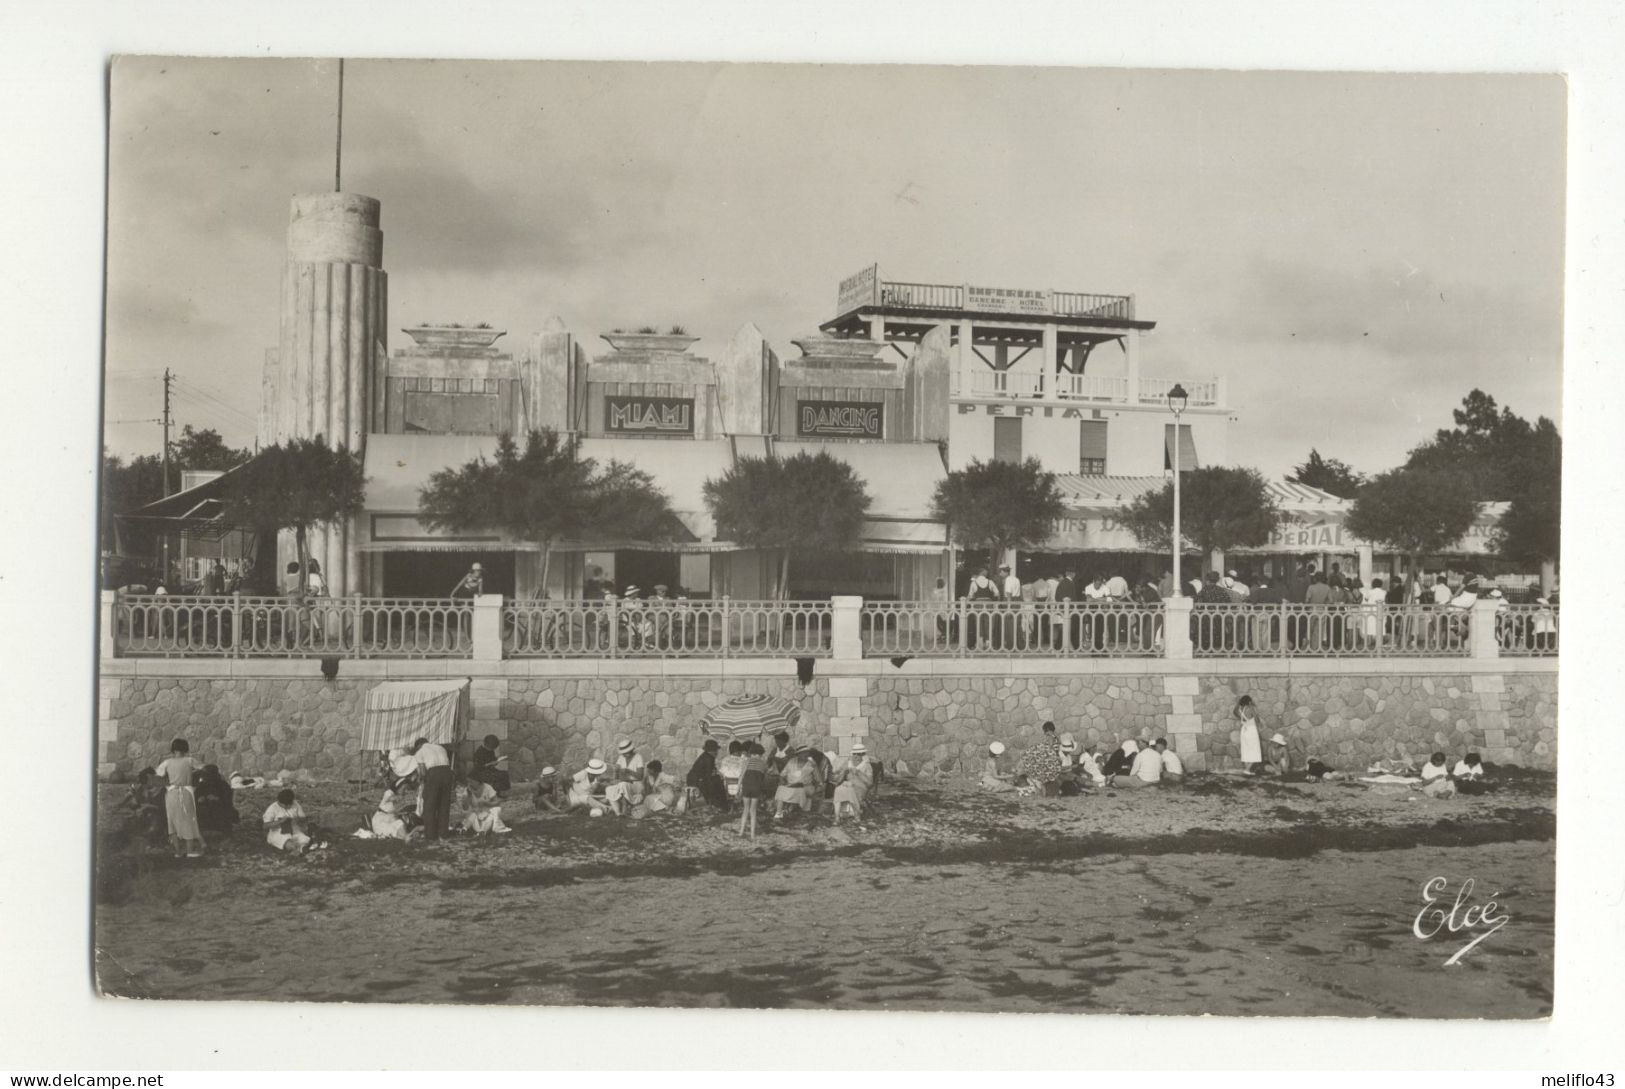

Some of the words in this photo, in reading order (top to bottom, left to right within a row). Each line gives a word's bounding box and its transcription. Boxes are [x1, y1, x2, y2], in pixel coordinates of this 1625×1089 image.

[968, 287, 1046, 300] IMPERIAL
[611, 402, 690, 430] MIAMI
[802, 406, 878, 434] DANCING
[1271, 524, 1345, 546] PERIAL
